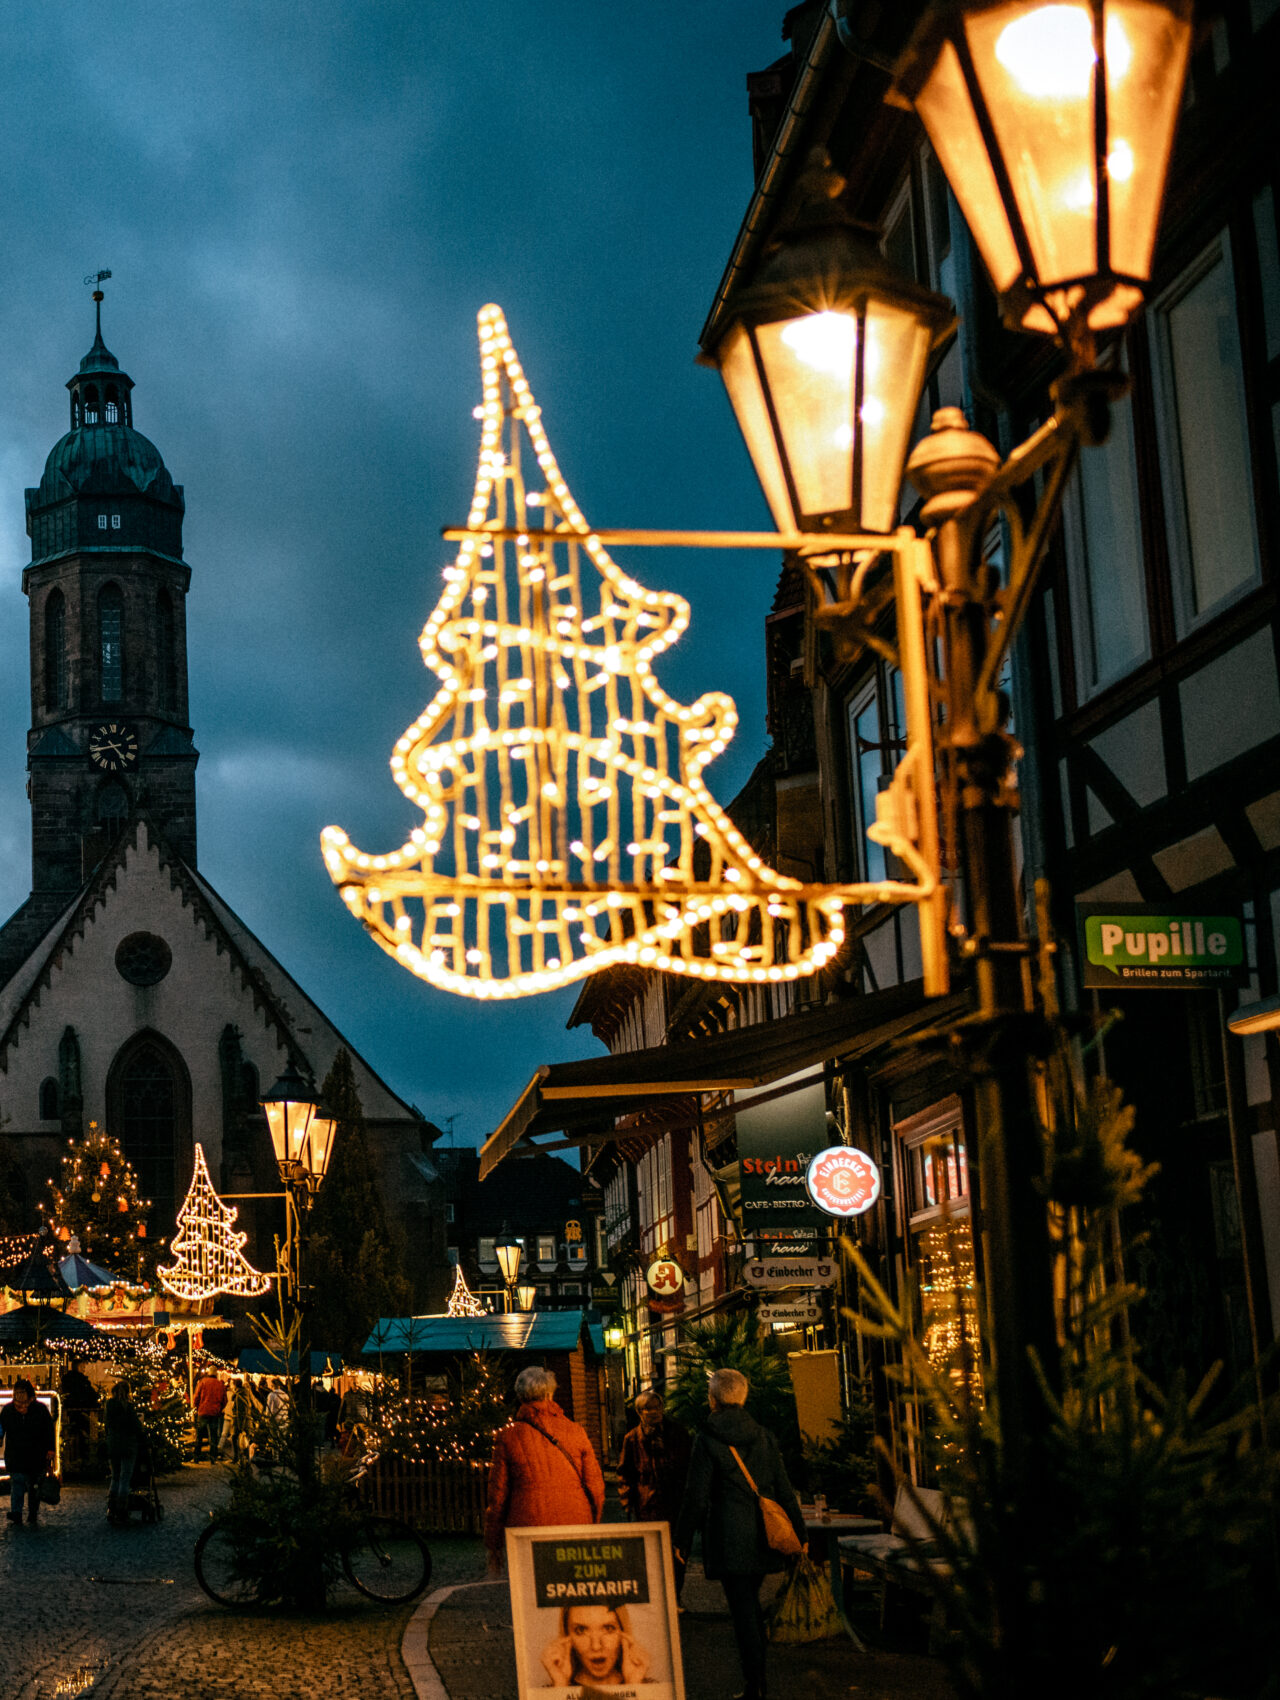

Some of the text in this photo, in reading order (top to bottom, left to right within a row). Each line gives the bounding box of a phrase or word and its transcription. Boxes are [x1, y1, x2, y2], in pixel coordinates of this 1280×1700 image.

[1100, 921, 1228, 962] Pupille
[1122, 967, 1158, 978] Brillen
[1161, 969, 1182, 978] zum
[742, 1155, 799, 1175] Stein
[818, 1157, 867, 1178] EINBECKER
[772, 1199, 805, 1209] BISTRO
[770, 1241, 809, 1254] haus
[767, 1265, 814, 1278] Einbecker
[771, 1308, 806, 1318] Einbecker
[555, 1545, 623, 1562] BRILLEN
[573, 1563, 608, 1578] ZUM
[545, 1579, 639, 1598] SPARTARIF!
